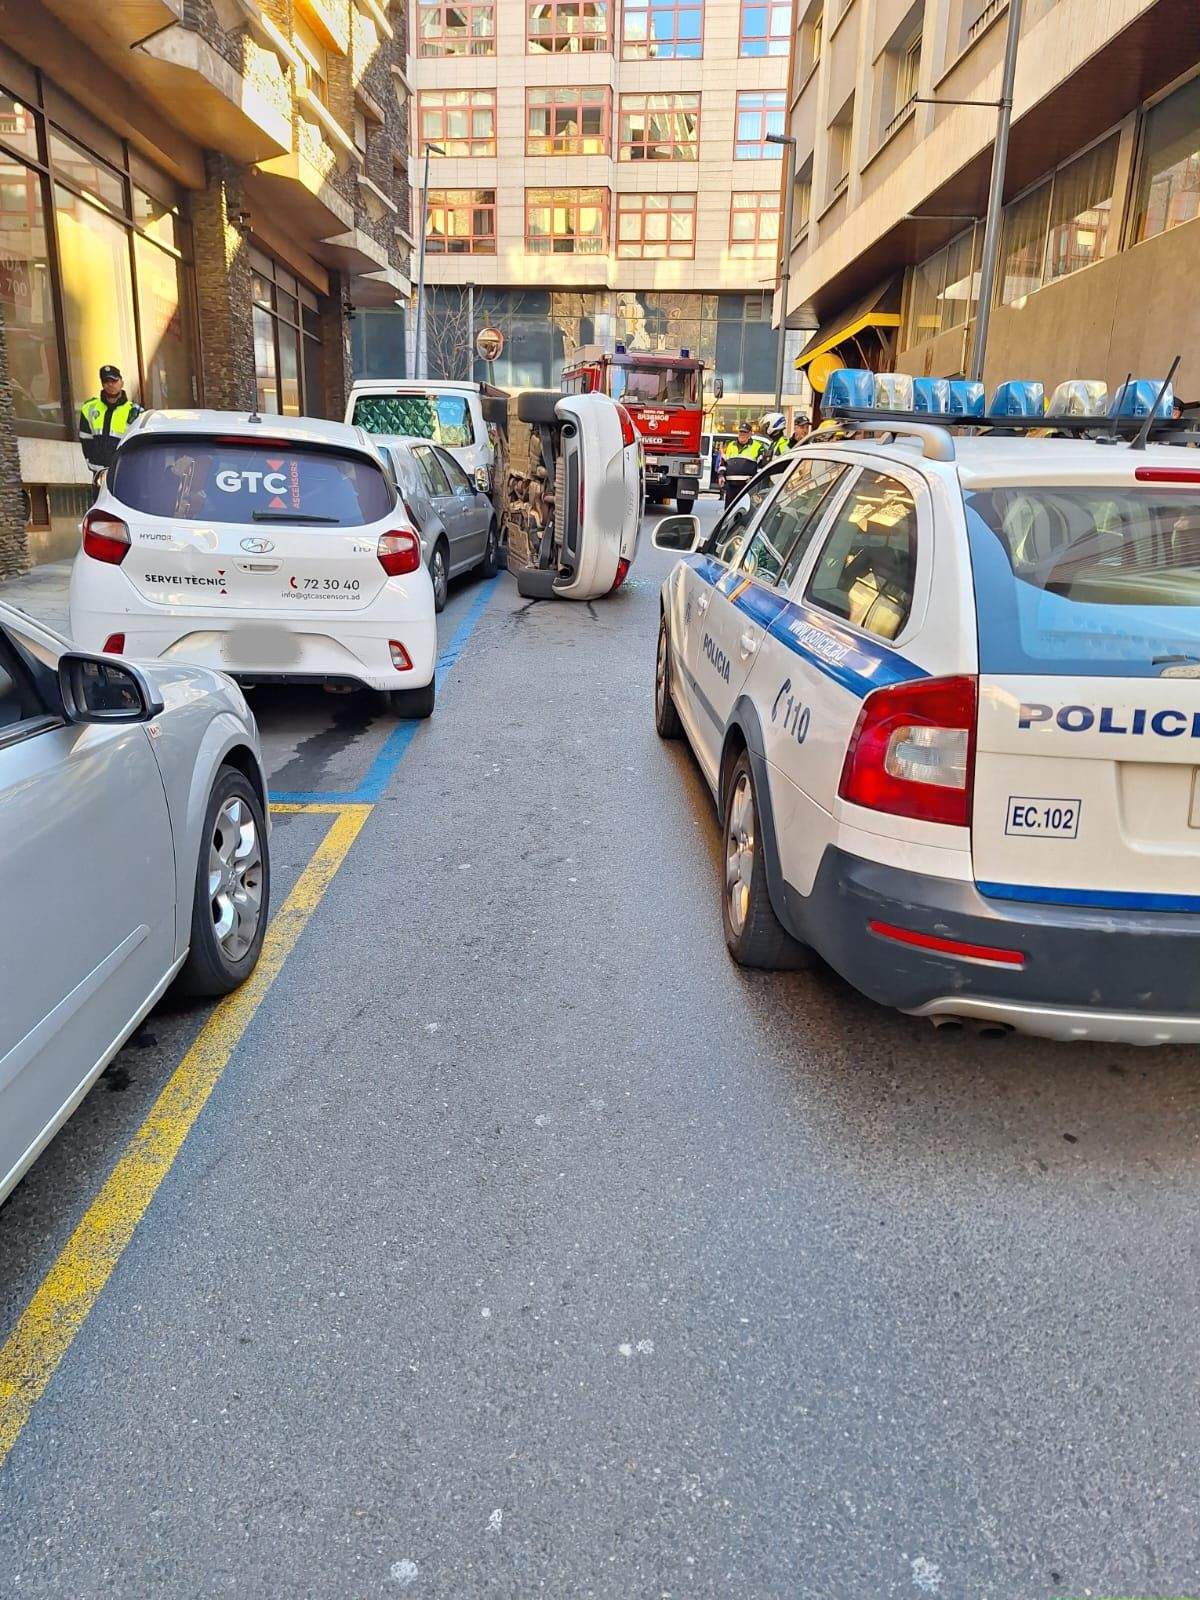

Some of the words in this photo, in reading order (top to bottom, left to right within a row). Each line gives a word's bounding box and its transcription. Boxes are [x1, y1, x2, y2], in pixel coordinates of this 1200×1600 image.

[215, 470, 288, 496] GTC
[289, 462, 301, 509] ASCENSORS
[139, 533, 174, 541] HYUNDA
[145, 574, 182, 584] SERVEI
[184, 574, 226, 586] TÈCNIC
[303, 578, 319, 589] 72
[323, 579, 340, 590] 30
[343, 579, 360, 590] 40
[281, 591, 361, 600] info@gtcascensors.ad
[702, 632, 731, 684] POLICIA
[783, 695, 811, 744] 110
[1012, 806, 1074, 829] EC.102
